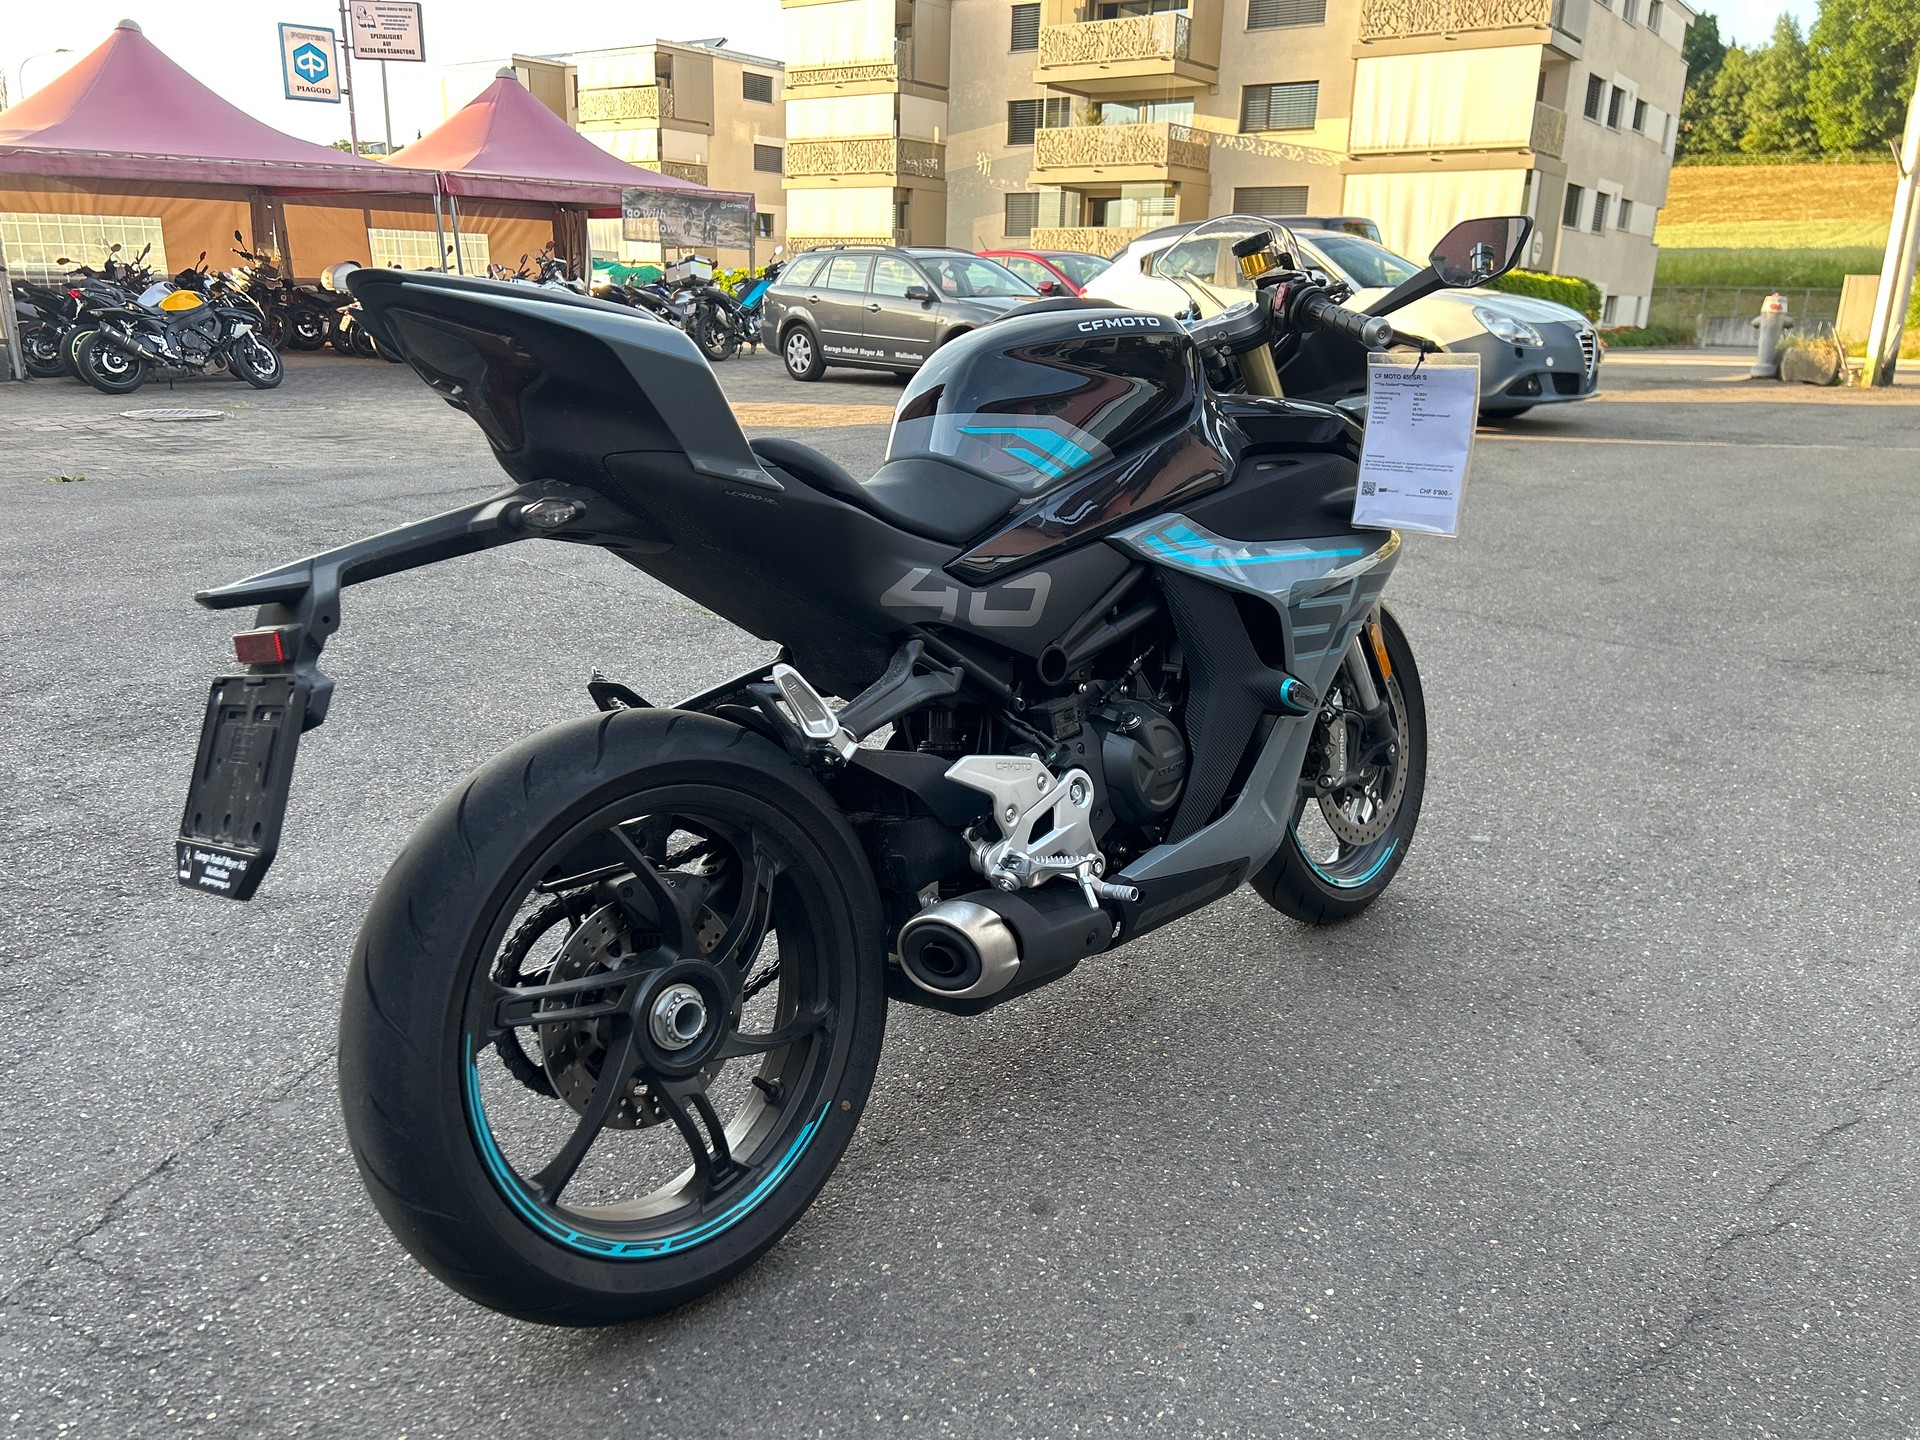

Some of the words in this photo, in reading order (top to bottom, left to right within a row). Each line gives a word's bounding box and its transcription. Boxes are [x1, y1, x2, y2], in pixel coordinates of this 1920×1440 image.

[297, 85, 331, 95] PIAGGIO
[626, 208, 640, 220] go
[643, 208, 667, 220] with
[632, 220, 648, 232] the
[652, 222, 677, 233] flow
[1077, 317, 1161, 332] CFMOTO
[823, 344, 842, 354] Garage
[842, 346, 859, 354] Rudolf
[860, 348, 876, 357] Meyer
[876, 349, 884, 357] AG
[996, 762, 1032, 771] CFMOTO
